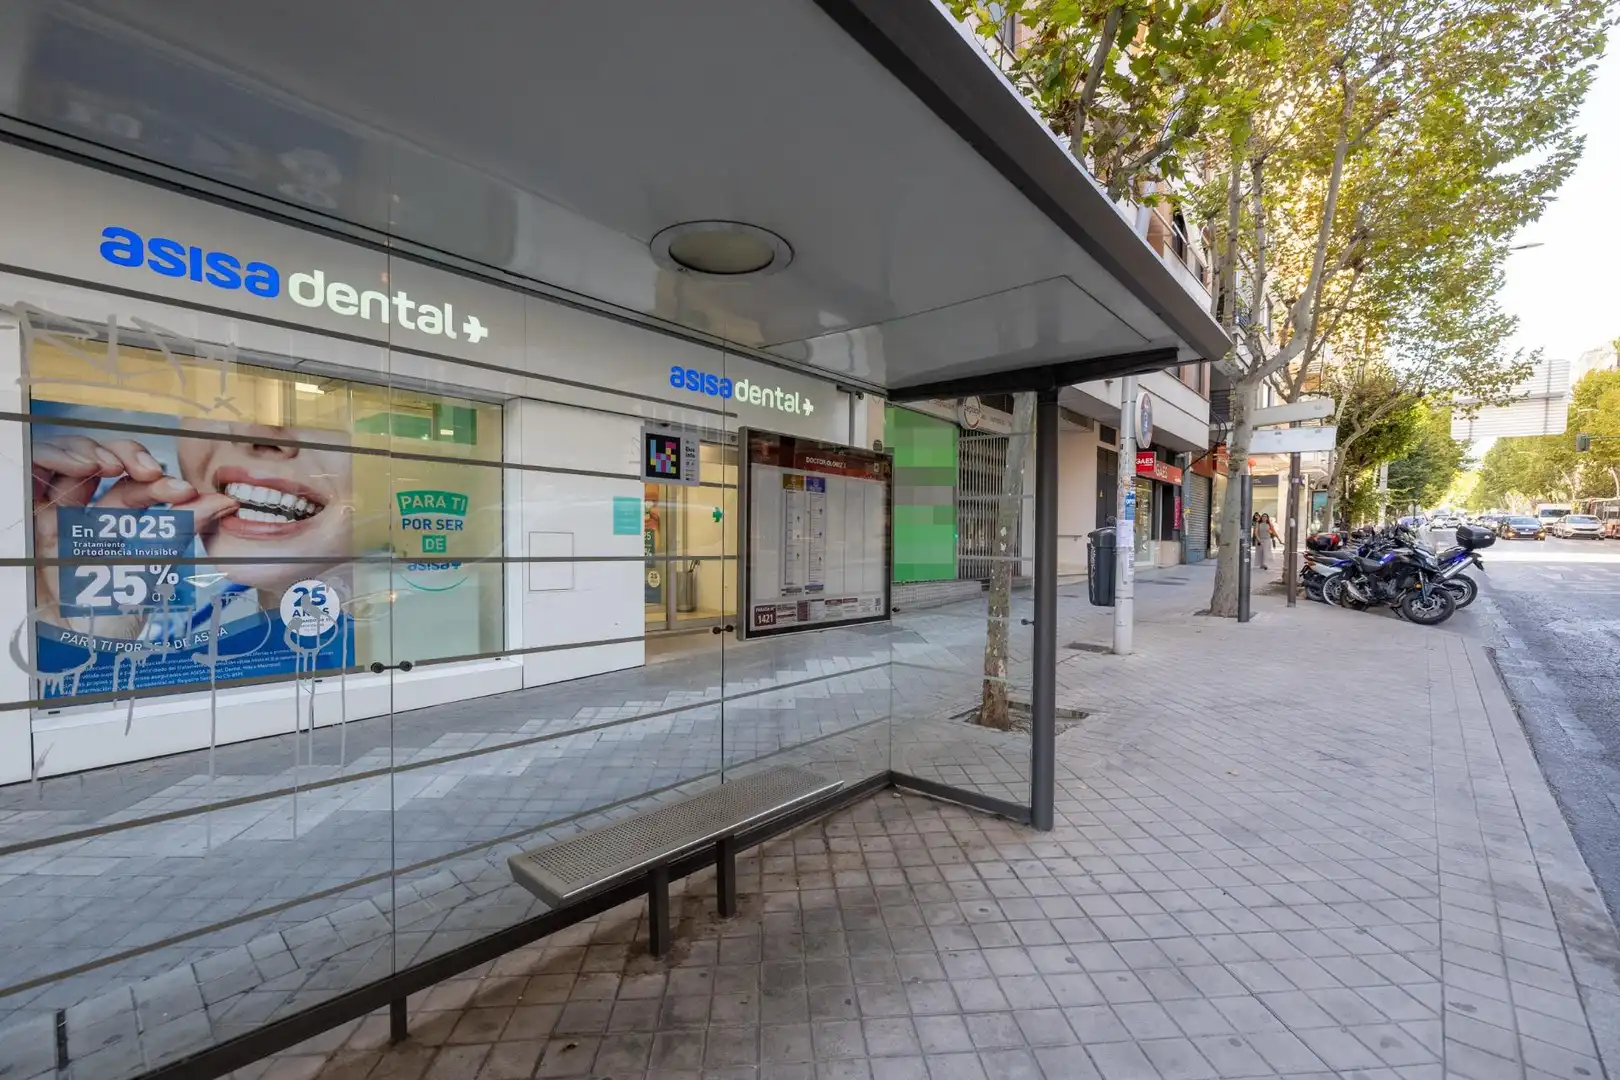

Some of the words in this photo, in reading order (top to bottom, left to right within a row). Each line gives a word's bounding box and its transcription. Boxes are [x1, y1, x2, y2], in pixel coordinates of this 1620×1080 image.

[100, 226, 280, 299] asisa
[288, 269, 457, 340] dental
[669, 365, 733, 399] asisa
[734, 378, 801, 415] dental
[1135, 457, 1154, 465] GAES
[400, 494, 447, 510] PARA
[451, 496, 466, 512] TI
[72, 525, 94, 538] En
[98, 514, 176, 539] 2025
[402, 518, 432, 530] POR
[436, 519, 464, 530] SER
[73, 548, 132, 556] Ortodoncia
[425, 538, 445, 550] DE
[292, 586, 327, 608] 25
[757, 613, 774, 625] 1421
[60, 631, 97, 650] PARA
[100, 640, 112, 651] TI
[115, 642, 143, 653] POR
